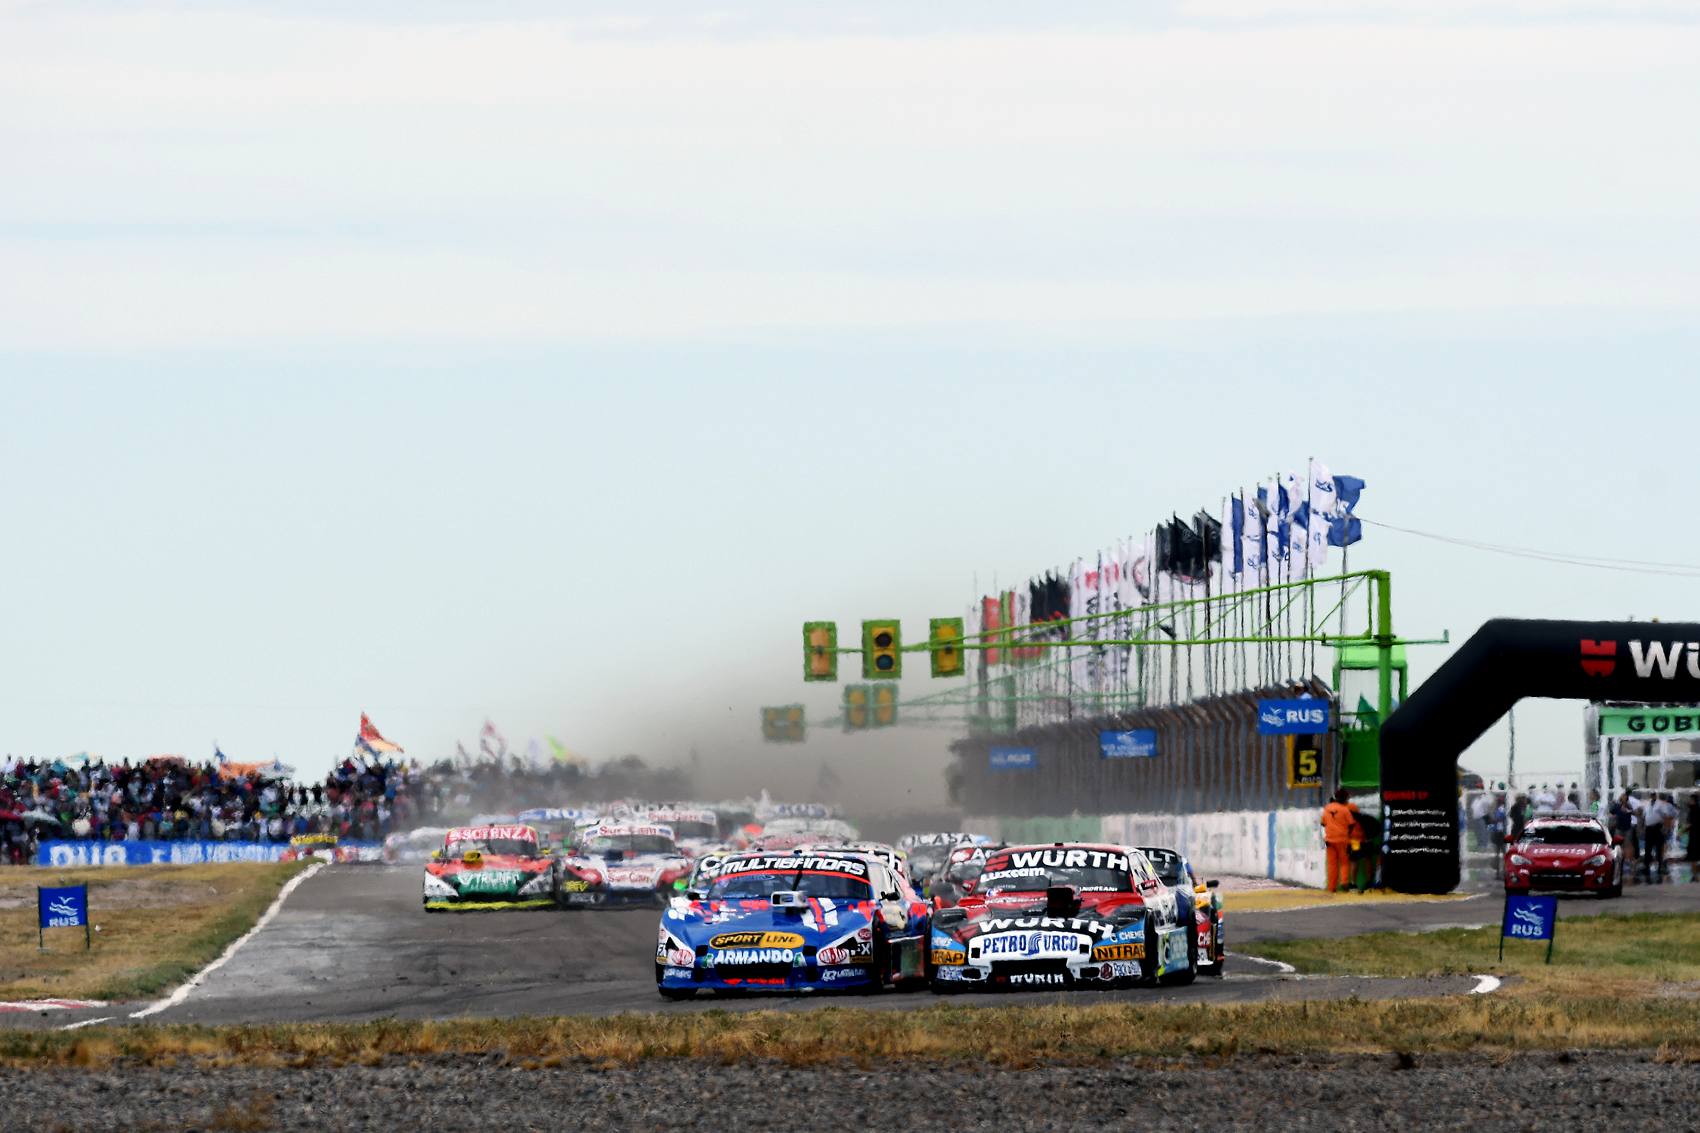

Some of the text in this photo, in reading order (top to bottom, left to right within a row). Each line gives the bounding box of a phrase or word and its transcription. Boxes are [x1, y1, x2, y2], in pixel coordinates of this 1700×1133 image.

[1286, 709, 1324, 724] RUS
[1627, 715, 1700, 732] GOB
[1299, 750, 1317, 776] 5
[722, 857, 865, 876] MULTIBANDAS
[49, 917, 80, 928] RUS
[1511, 924, 1543, 936] RUS
[716, 934, 761, 945] SPORT
[714, 949, 793, 965] ARMANDO
